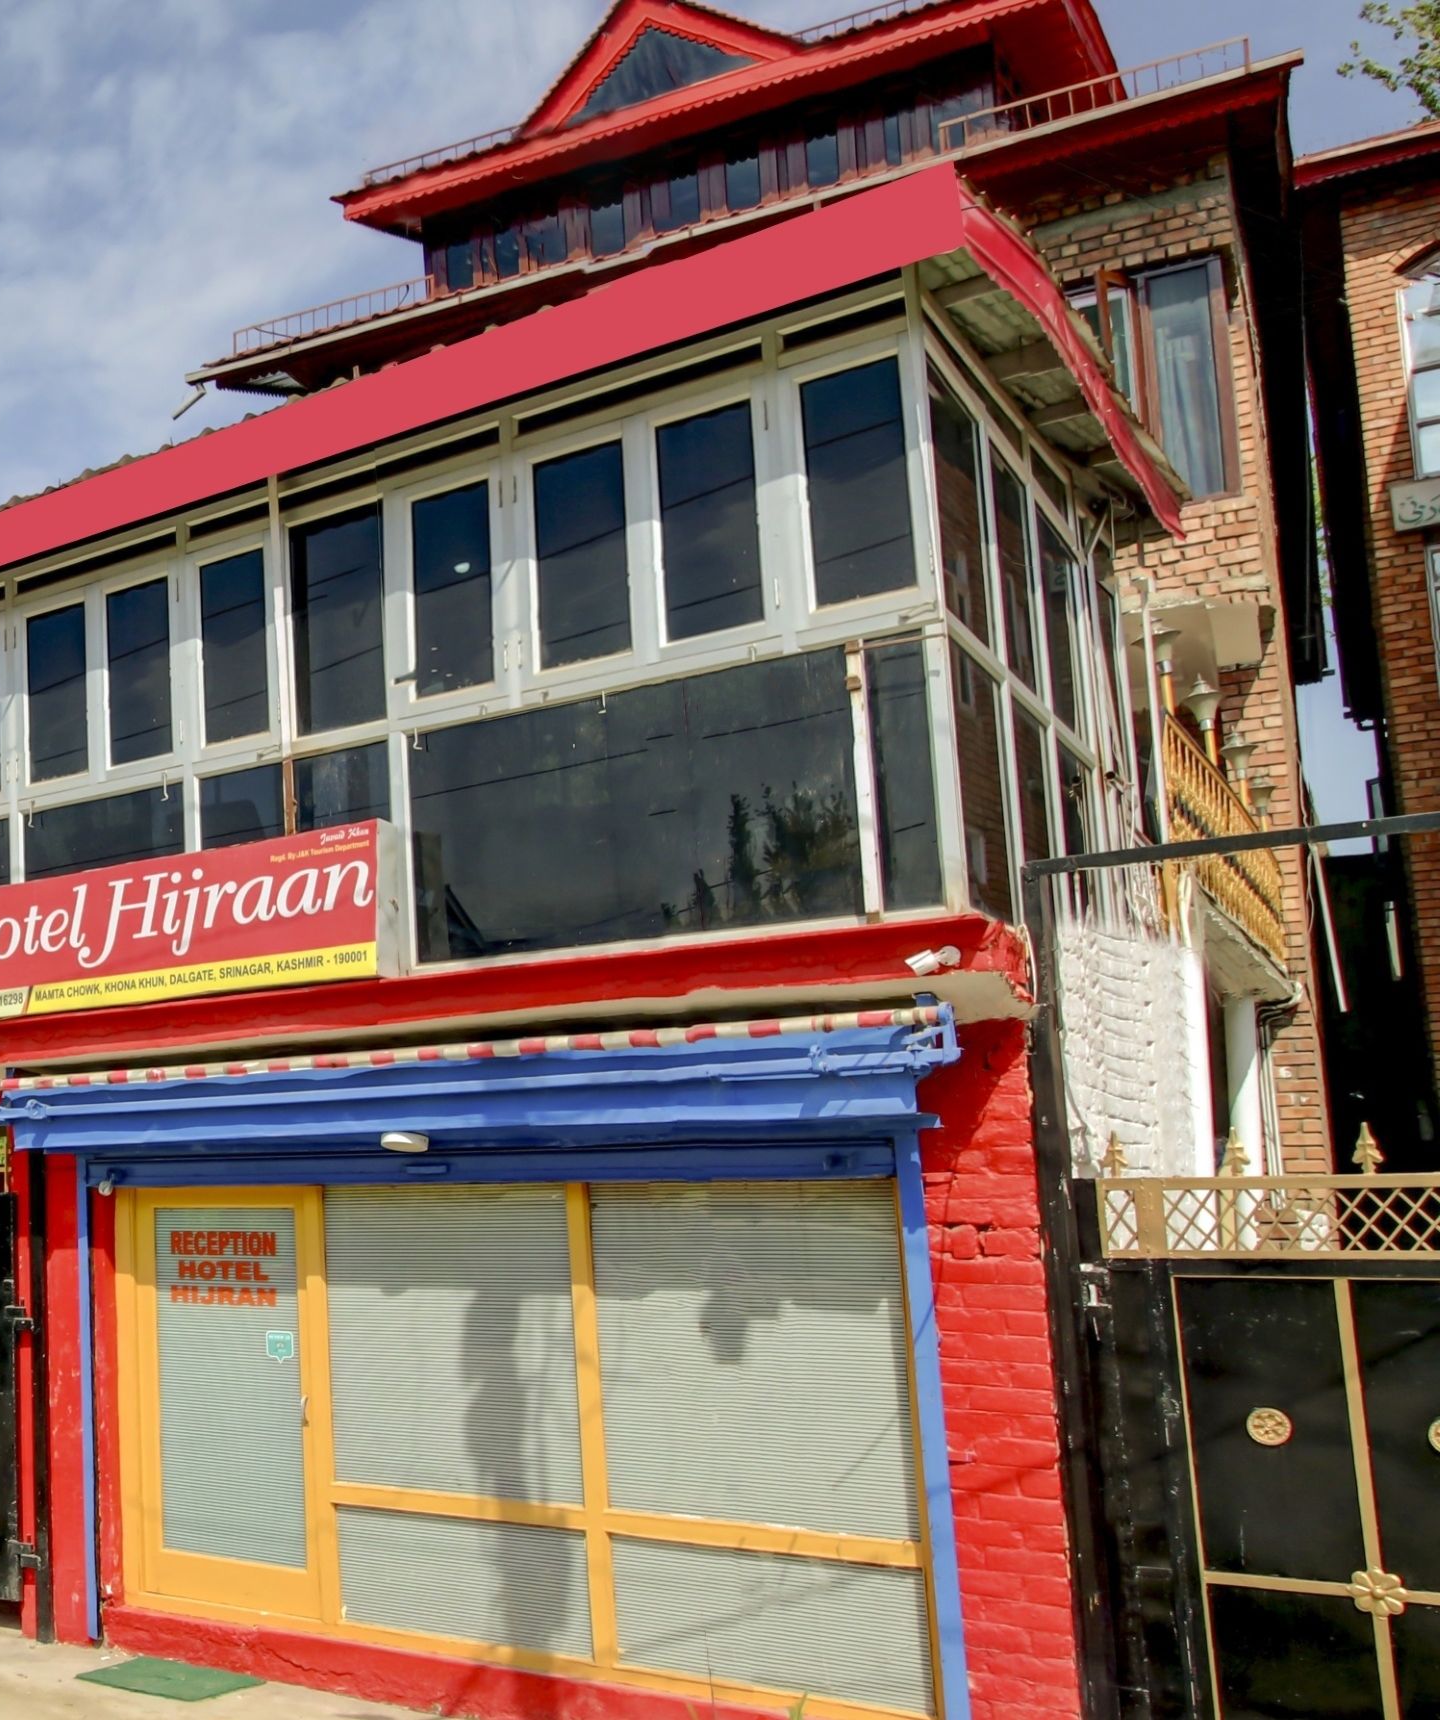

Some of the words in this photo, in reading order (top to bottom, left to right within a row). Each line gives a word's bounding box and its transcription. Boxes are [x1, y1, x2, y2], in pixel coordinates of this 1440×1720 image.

[347, 826, 370, 840] Khan
[310, 846, 334, 856] Tourism
[334, 839, 370, 853] Department
[77, 859, 374, 969] Hijraan
[35, 988, 65, 1001] MAMTA
[66, 983, 103, 998] CHOWK,
[104, 979, 137, 993] KHONA
[138, 975, 167, 989] KHUN,
[169, 969, 217, 985] DALGATE,
[219, 963, 274, 979] SRINAGAR,
[276, 955, 324, 972] KASHMIR
[333, 950, 368, 965] 190001
[170, 1230, 277, 1257] RECEPTION
[178, 1260, 270, 1281] HOTEL
[169, 1285, 277, 1307] HIJRAN
